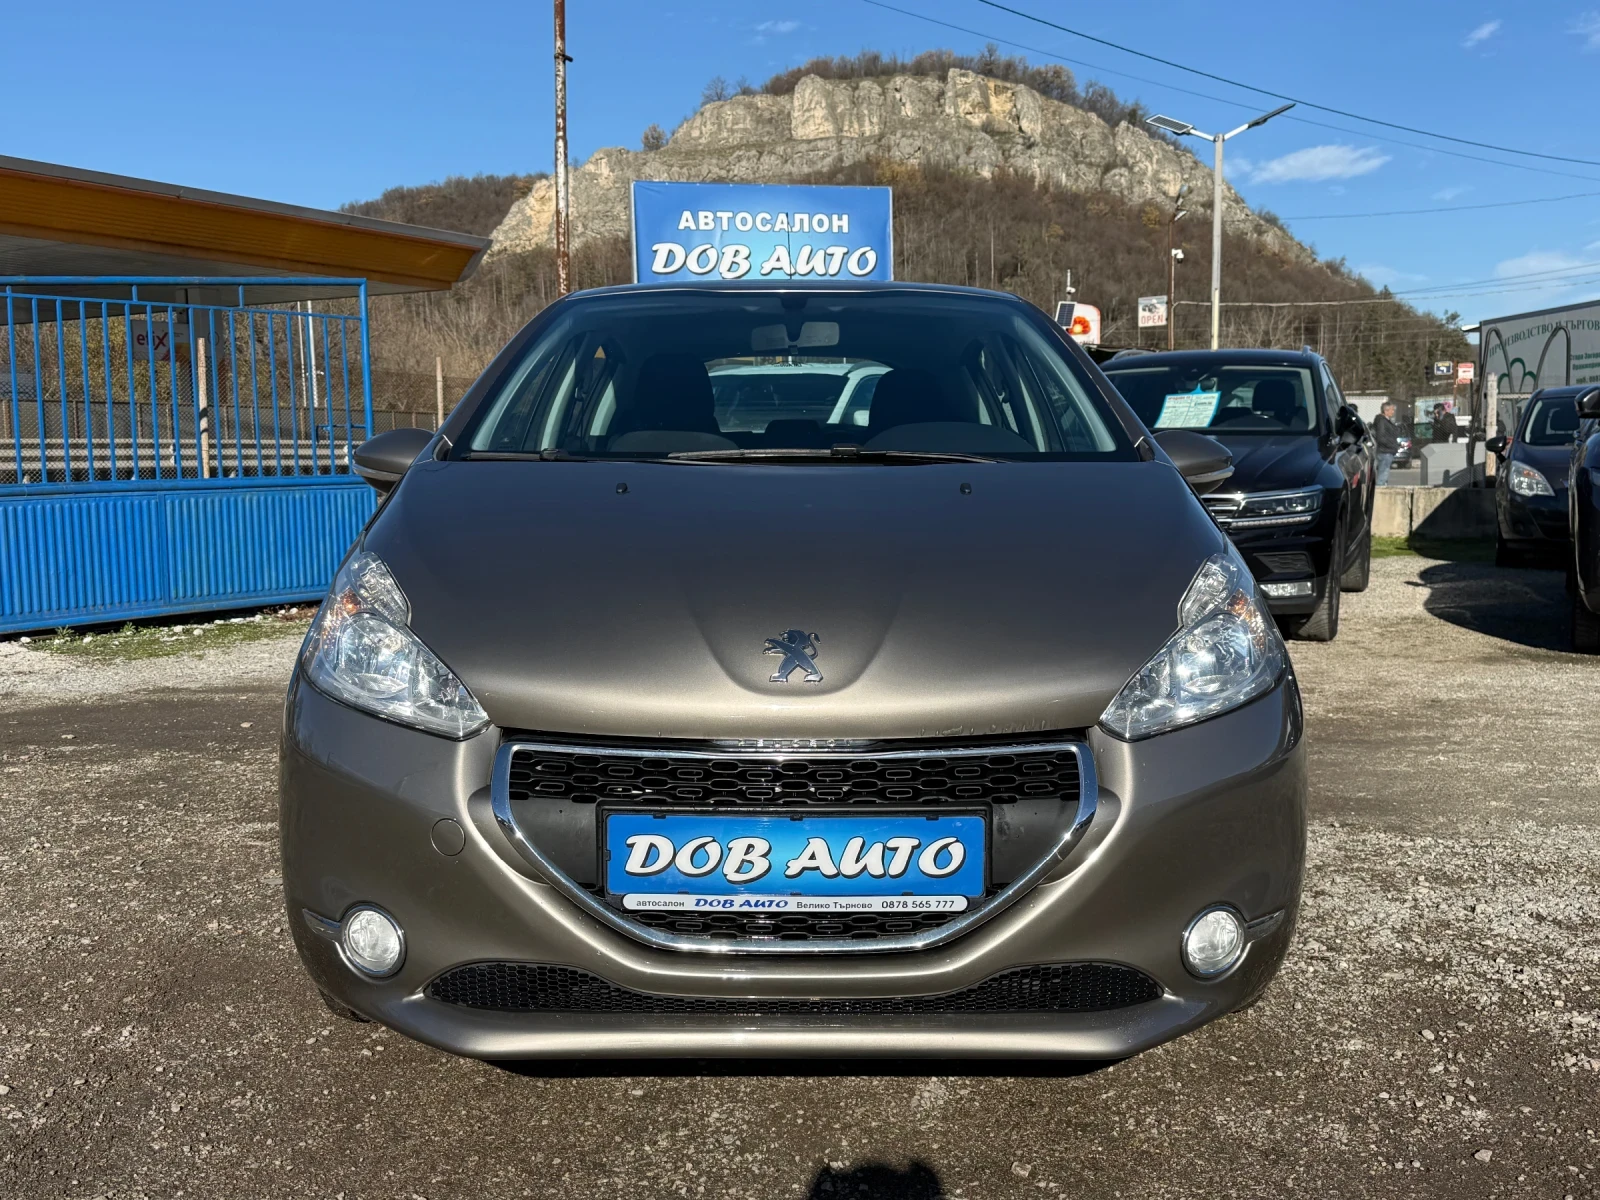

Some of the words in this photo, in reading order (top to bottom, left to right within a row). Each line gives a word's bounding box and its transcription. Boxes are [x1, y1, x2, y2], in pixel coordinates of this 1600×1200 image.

[678, 210, 849, 233] АВТОСАЛОН
[651, 242, 751, 279] DOB
[760, 245, 877, 276] AUTO
[1141, 314, 1164, 325] OPEN
[624, 834, 772, 884] DOB
[784, 836, 966, 878] AUTO
[636, 900, 685, 908] автосалон
[694, 898, 735, 909] DOB
[739, 899, 788, 908] AUTO
[796, 901, 831, 909] Велико
[833, 901, 873, 910] Търново
[881, 900, 908, 909] 0878
[911, 900, 931, 909] 565
[935, 900, 955, 909] 777
